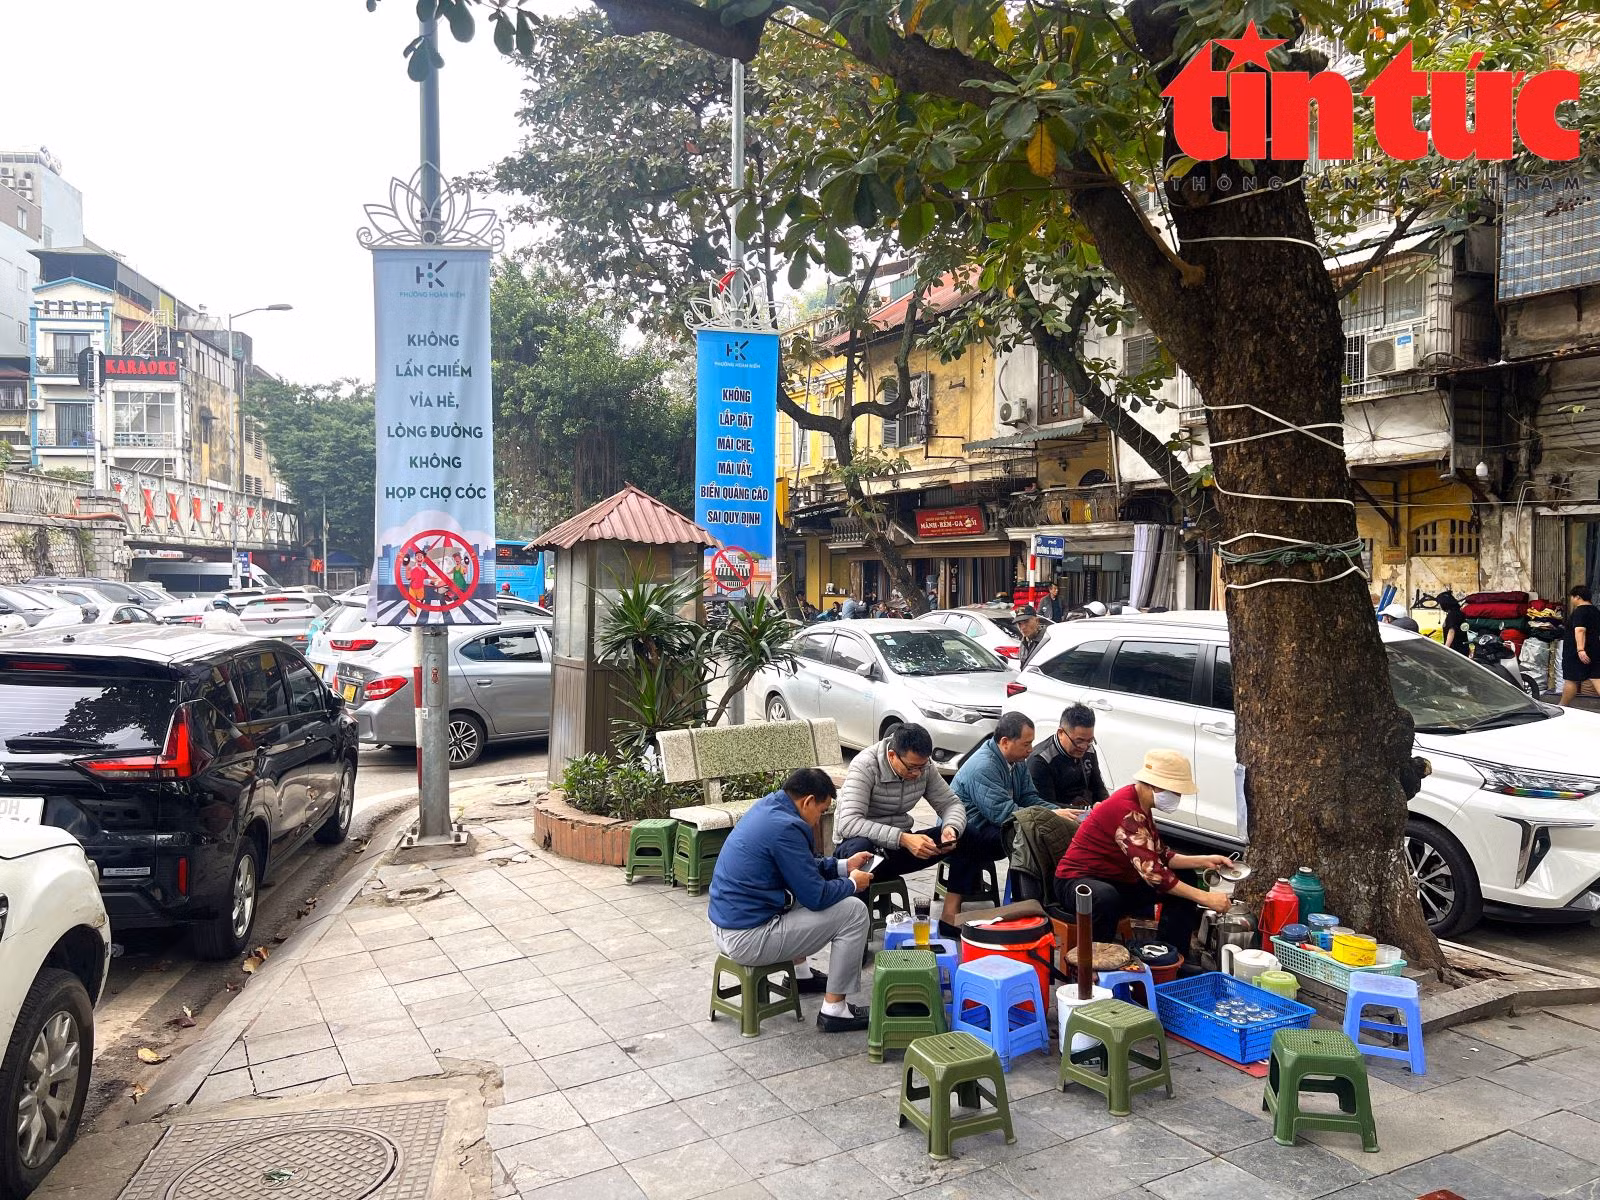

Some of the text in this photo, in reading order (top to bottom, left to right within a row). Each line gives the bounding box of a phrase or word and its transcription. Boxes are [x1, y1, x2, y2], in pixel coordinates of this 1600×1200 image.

[407, 330, 460, 347] KHÔNG
[105, 359, 177, 375] KARAOKE
[395, 358, 472, 377] LẤN CHIẾM
[409, 391, 460, 409] VỈA HÈ,
[722, 387, 751, 402] KHÔNG
[737, 412, 753, 430] ĐẶT
[387, 422, 483, 438] LÒNG ĐƯỜNG
[717, 436, 734, 450] MÁI
[409, 453, 462, 469] KHÔNG
[718, 461, 734, 474] MÁI
[385, 483, 487, 503] HỌP CHỢ CÓC
[722, 484, 750, 500] QUẢNG
[751, 486, 768, 500] CÁO
[707, 511, 721, 522] SAI
[741, 512, 760, 527] ĐỊNH
